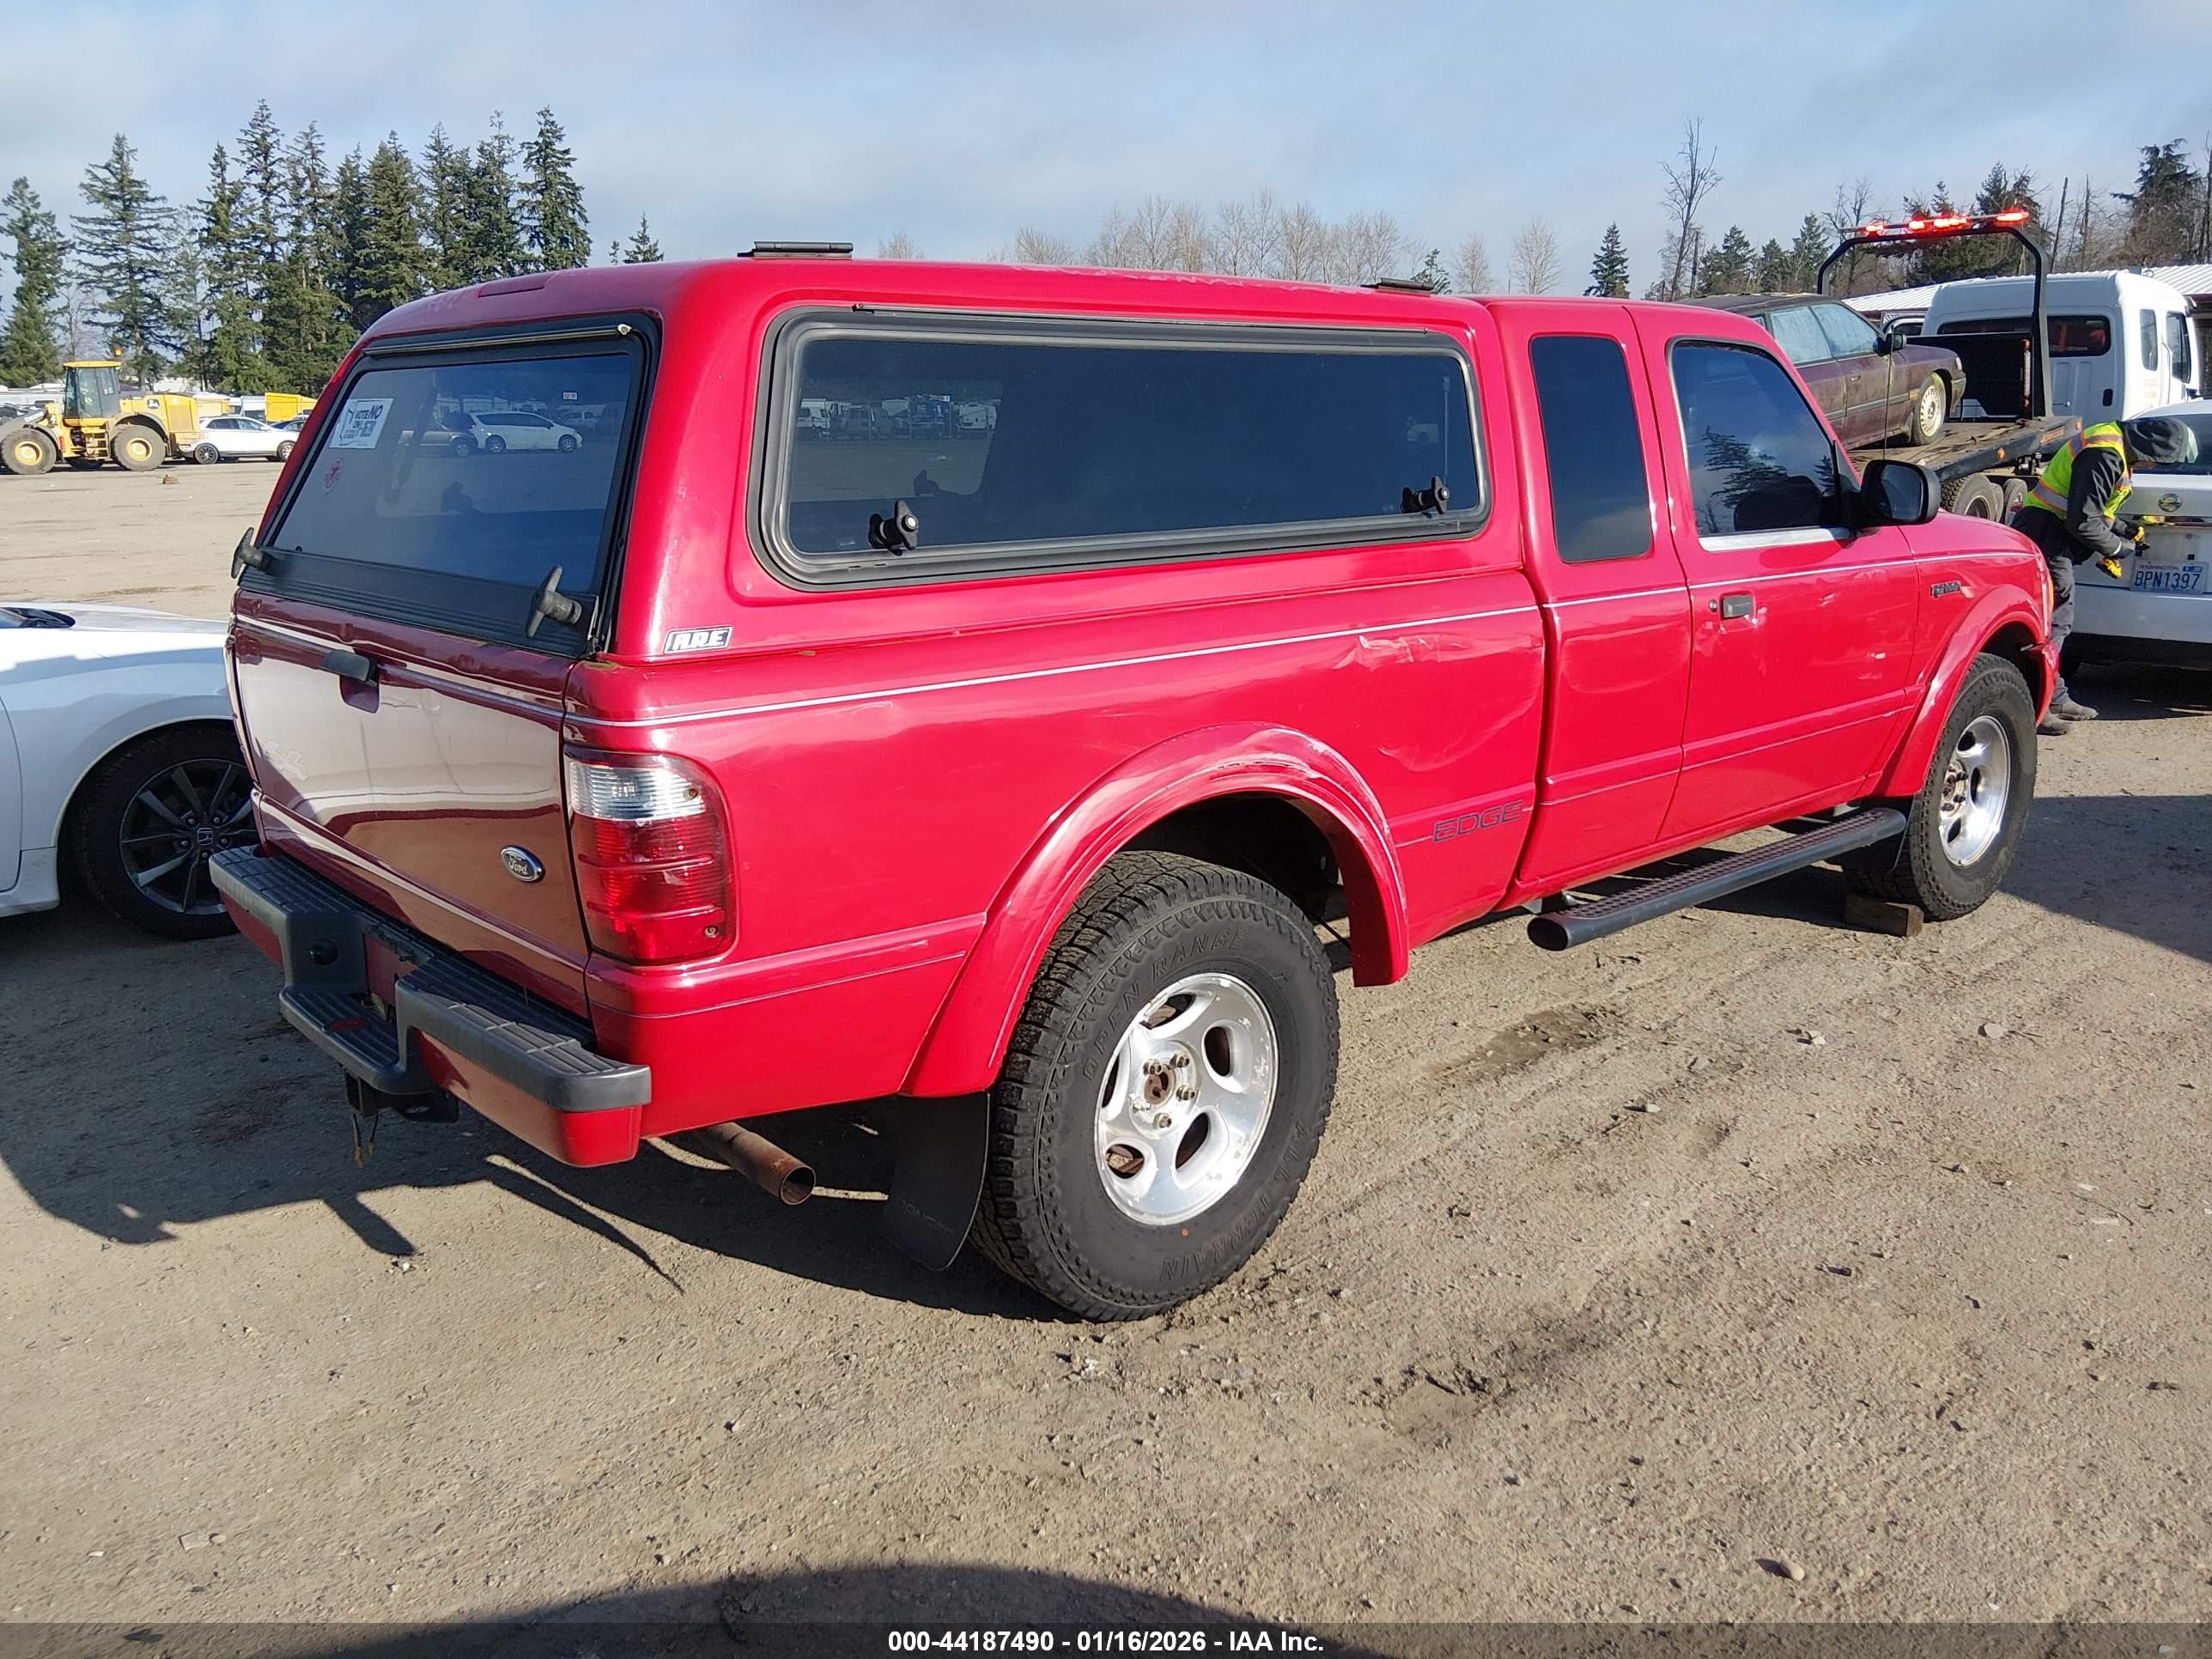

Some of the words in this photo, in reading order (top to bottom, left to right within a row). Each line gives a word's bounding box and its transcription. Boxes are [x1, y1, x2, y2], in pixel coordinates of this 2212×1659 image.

[368, 405, 384, 420] NO
[2135, 570, 2200, 589] BPN1397
[1433, 799, 1524, 842] EDGE
[1082, 981, 1140, 1081] OPEN
[1151, 929, 1249, 982] RANGE
[1273, 1120, 1308, 1182] ALL
